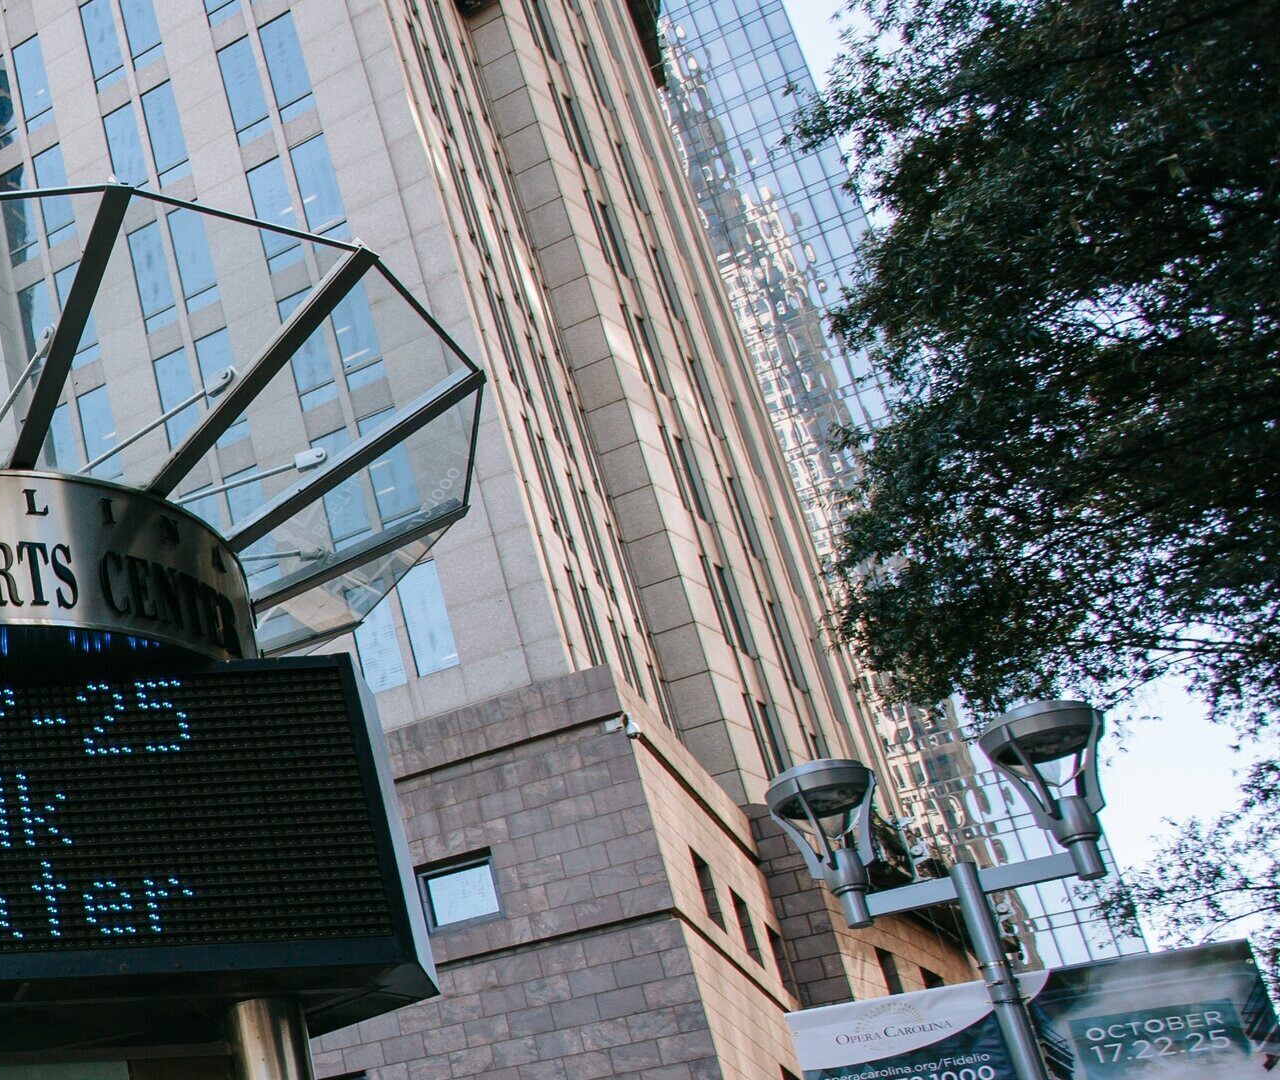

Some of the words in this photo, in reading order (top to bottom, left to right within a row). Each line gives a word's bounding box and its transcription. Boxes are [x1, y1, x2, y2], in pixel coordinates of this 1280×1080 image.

[100, 550, 244, 660] CENTER
[1085, 1010, 1224, 1041] OCTOBER
[1090, 1029, 1231, 1064] 17.22.25
